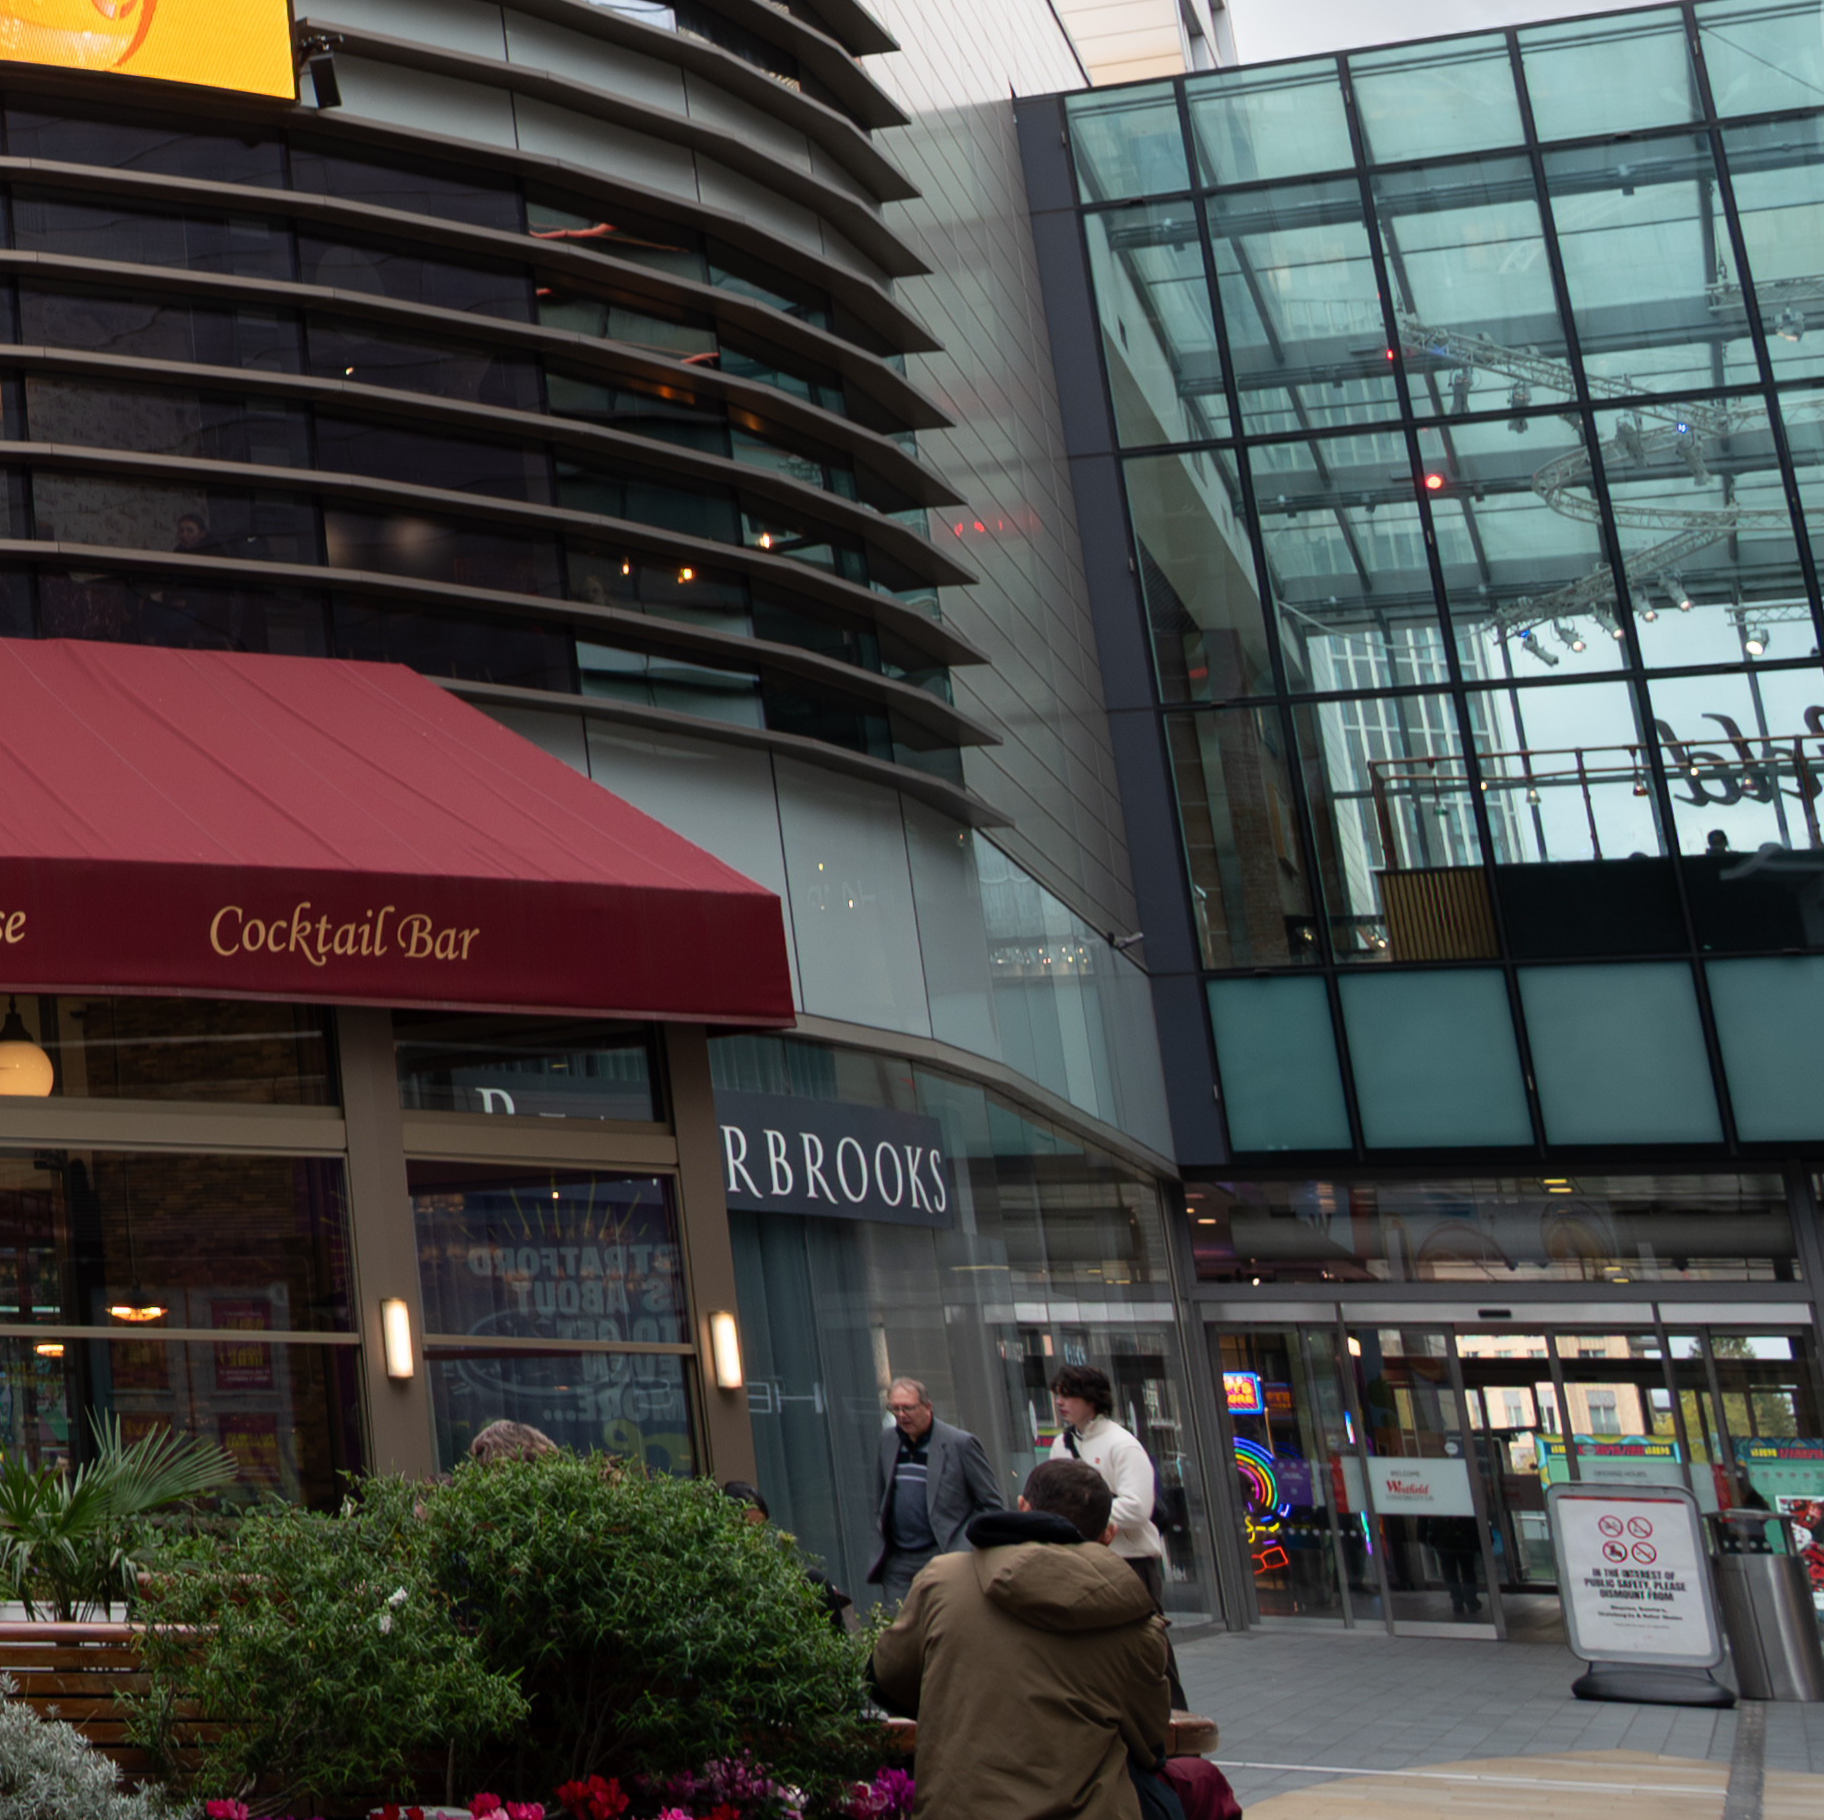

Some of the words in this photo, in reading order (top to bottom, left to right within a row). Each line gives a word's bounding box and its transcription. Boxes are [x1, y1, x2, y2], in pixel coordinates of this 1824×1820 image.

[208, 901, 396, 968] Cocktail
[398, 911, 480, 962] Bar
[1386, 1479, 1429, 1494] Westfield
[1584, 1578, 1614, 1588] PUBLIC
[1653, 1581, 1686, 1592] PLEASE
